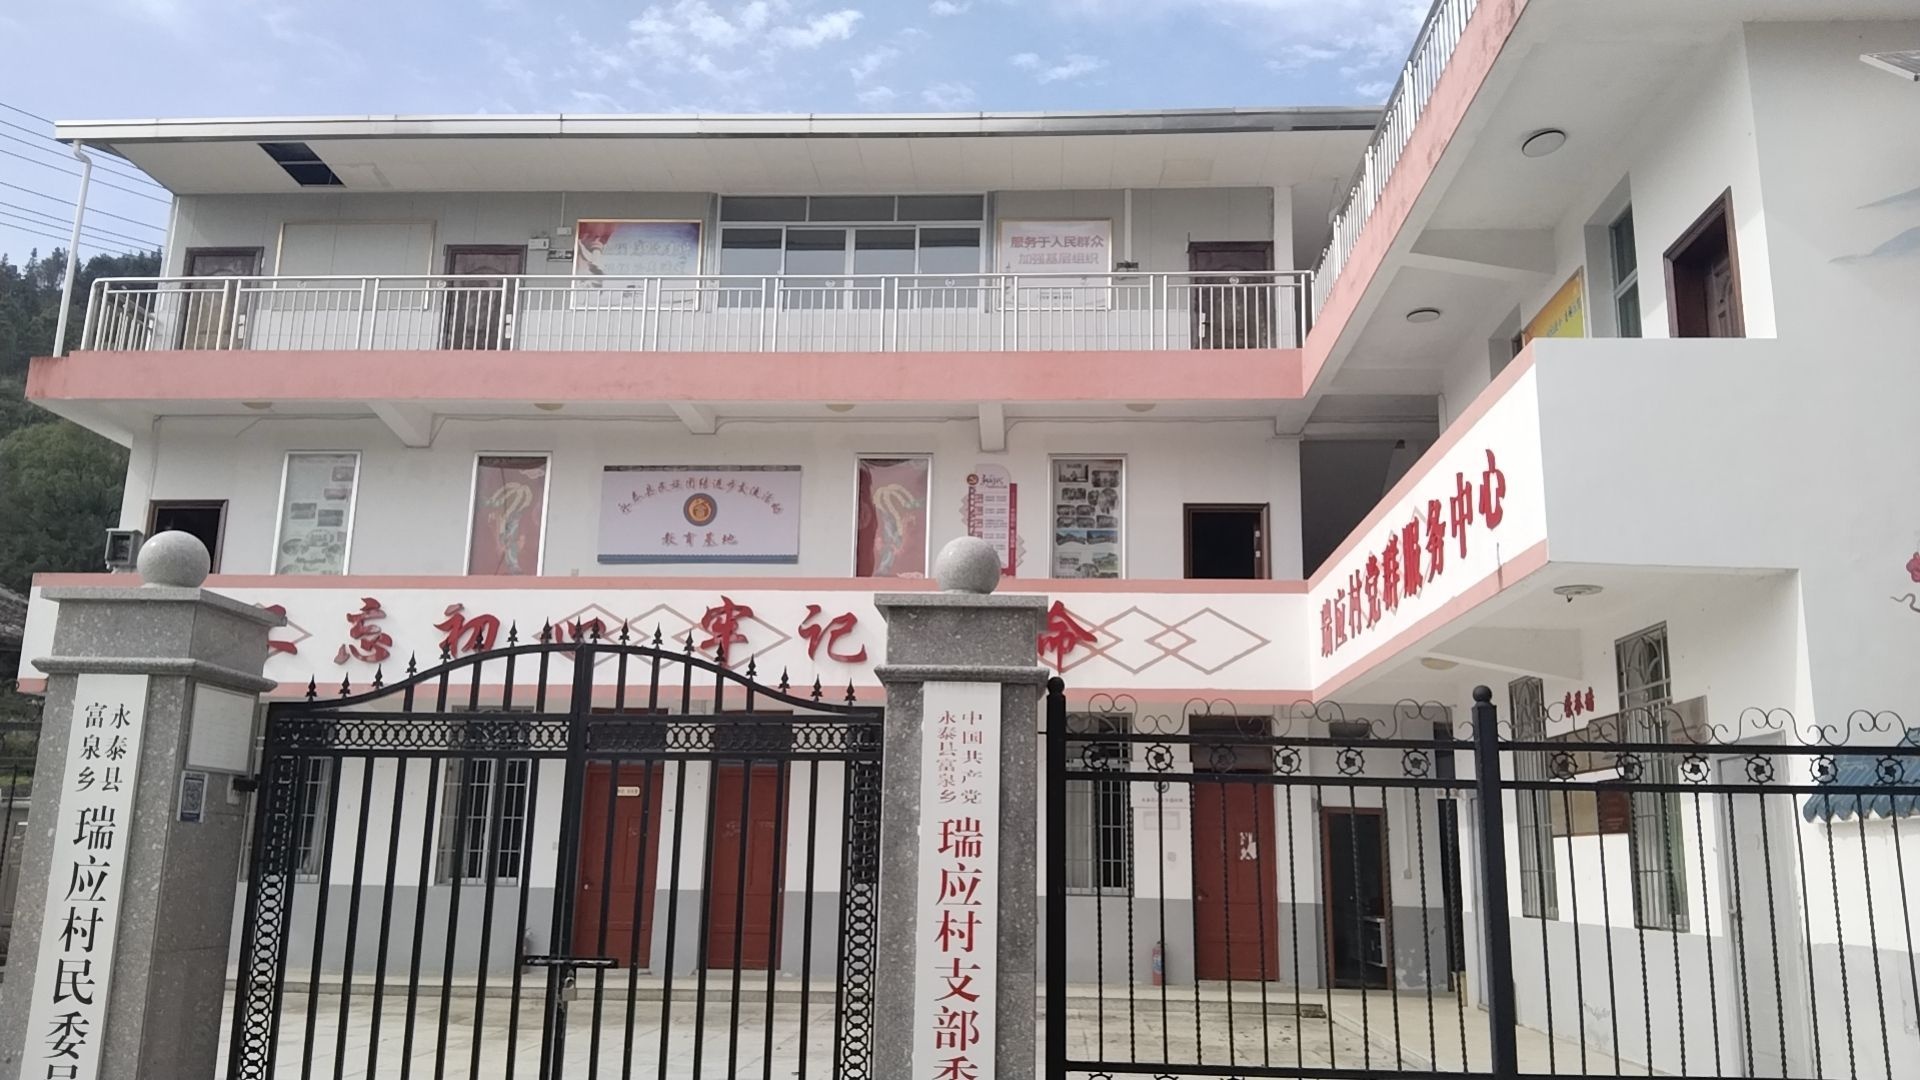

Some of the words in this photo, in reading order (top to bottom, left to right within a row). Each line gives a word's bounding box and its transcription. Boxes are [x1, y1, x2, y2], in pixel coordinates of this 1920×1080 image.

[1010, 234, 1105, 249] 服务于人民群众
[661, 531, 738, 547] 教育基地
[1320, 448, 1507, 658] 瑞应村党群服务中心
[75, 702, 107, 792] 富泉乡
[101, 703, 131, 792] 永泰县
[937, 710, 957, 804] 永泰县富泉乡
[962, 710, 983, 804] 中国共产党
